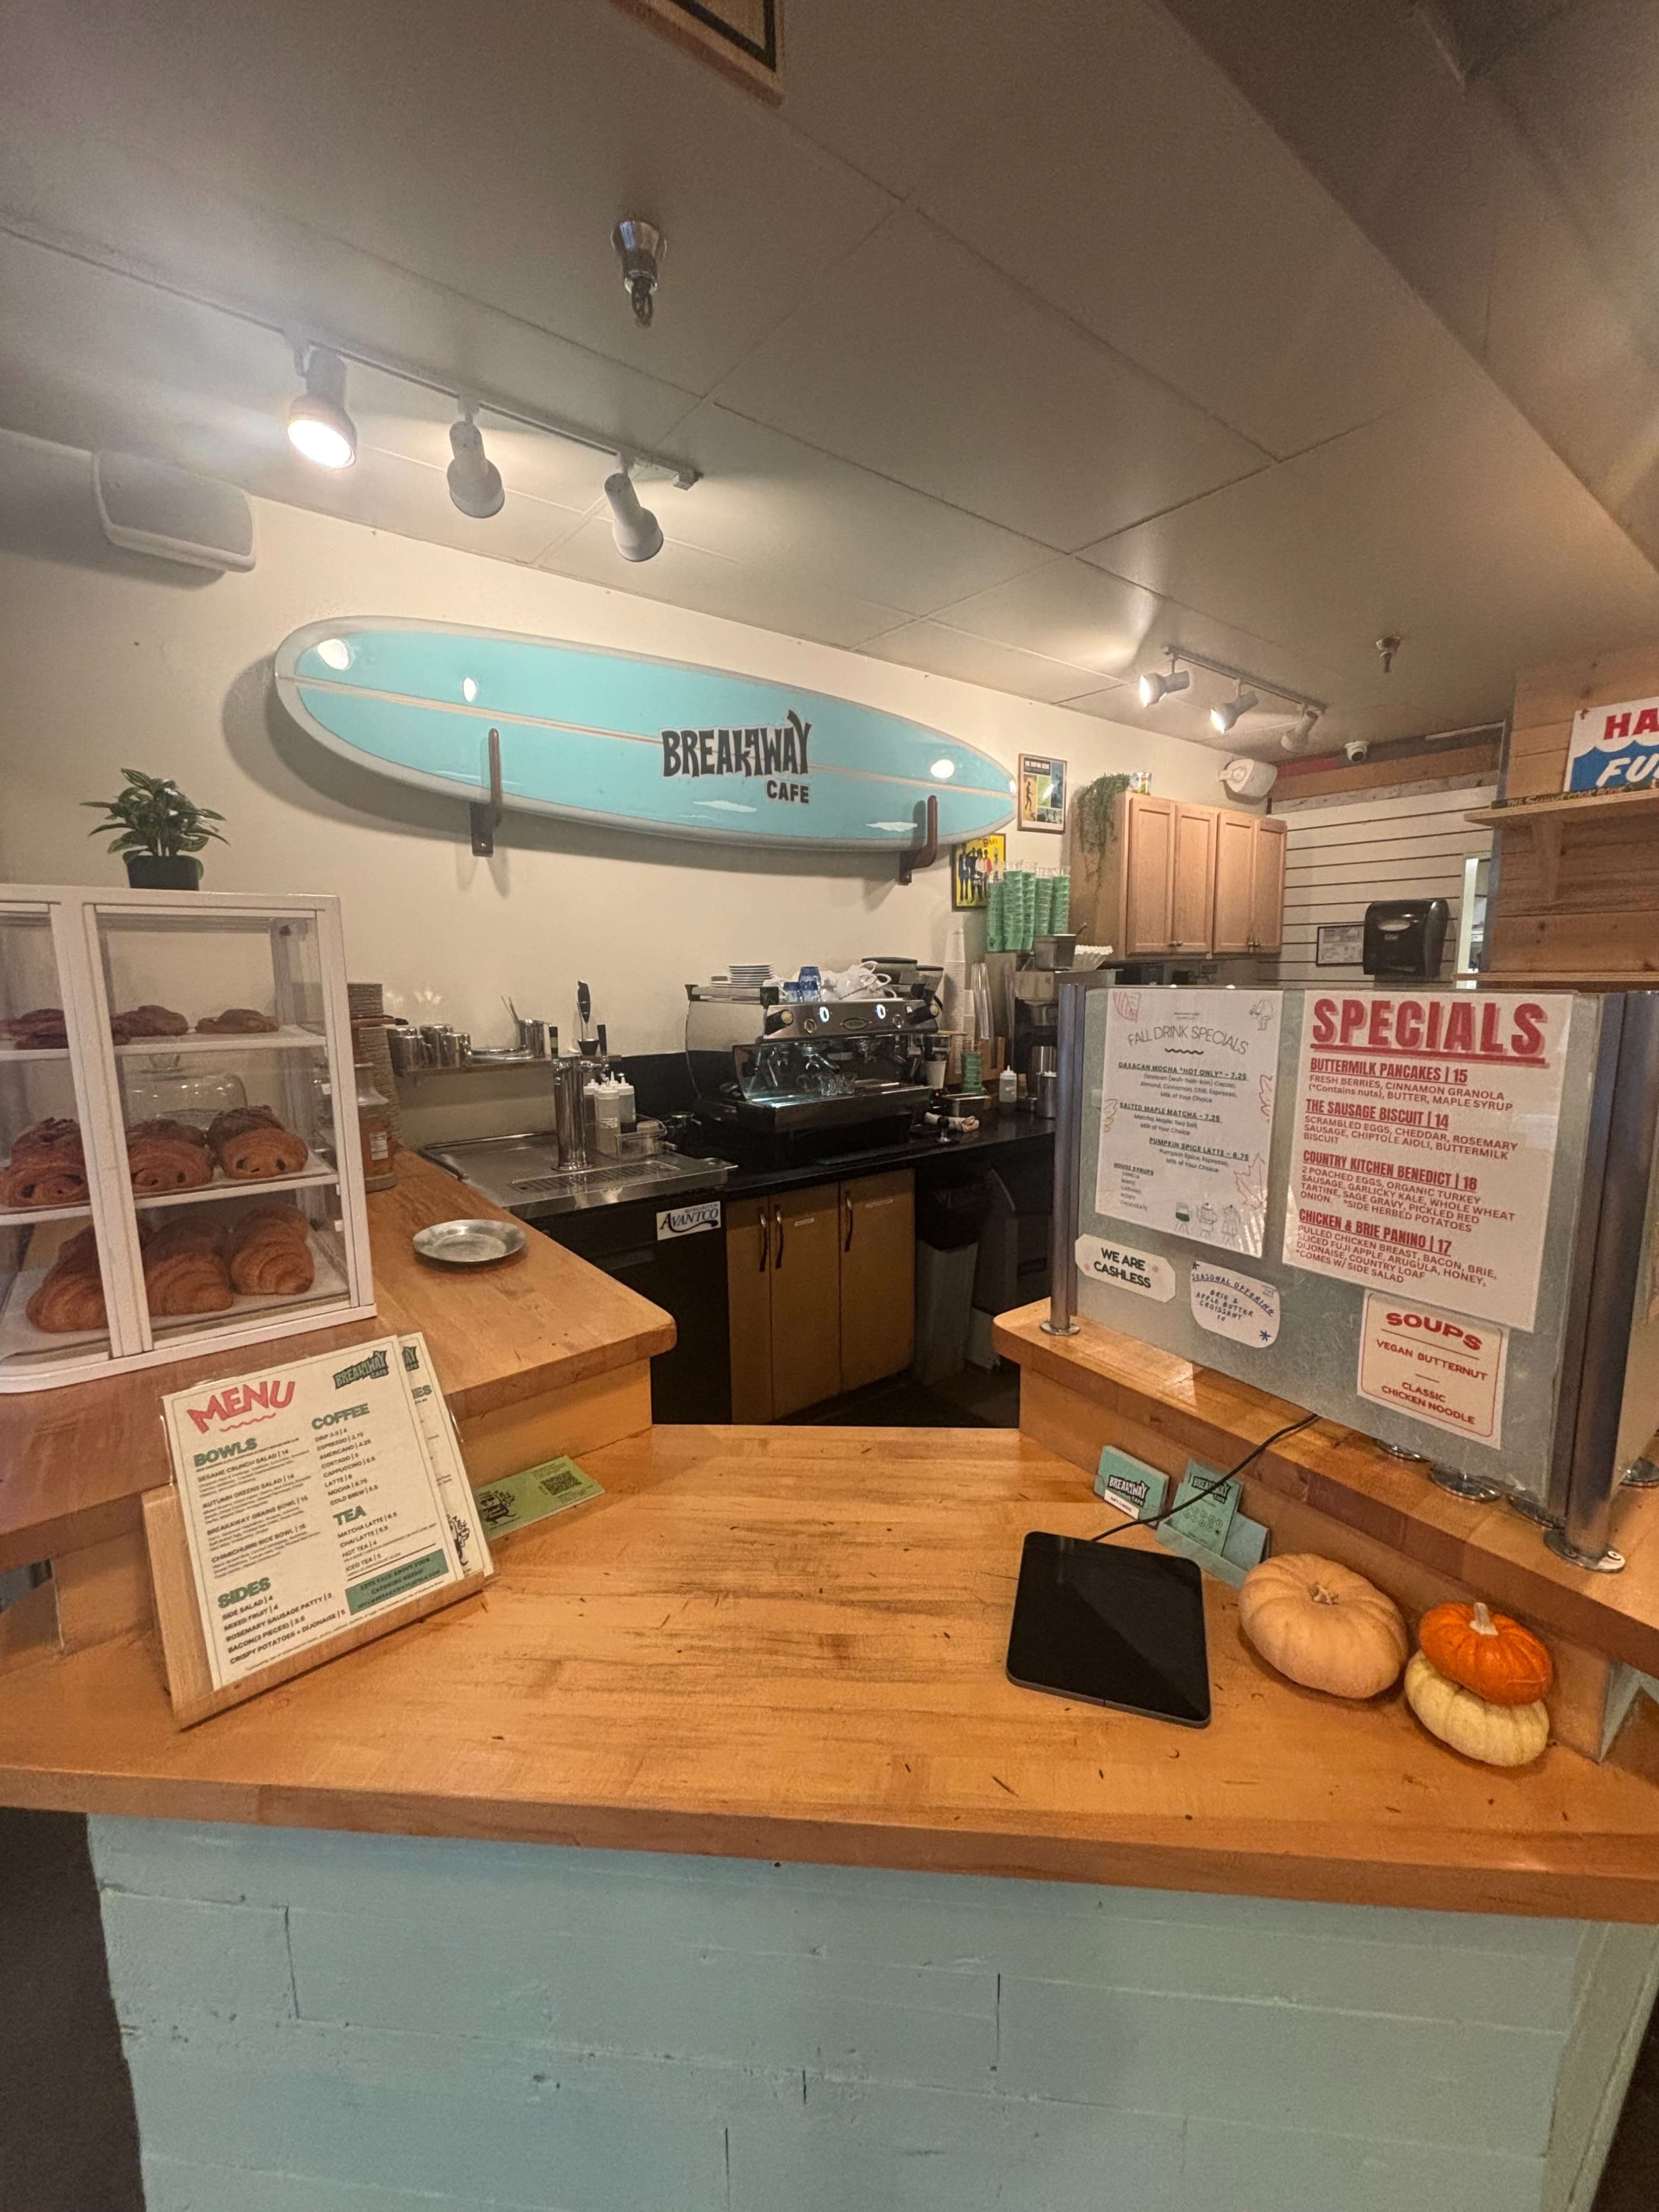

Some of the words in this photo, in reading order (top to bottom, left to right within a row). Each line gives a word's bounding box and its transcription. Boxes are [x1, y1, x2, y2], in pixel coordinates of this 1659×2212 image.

[661, 709, 812, 778] BREAKAWAY
[766, 780, 809, 804] CAFE
[1128, 1029, 1152, 1046] FALL
[1154, 1025, 1188, 1040] DRINK
[1191, 1026, 1249, 1055] SPECIALS
[1312, 998, 1548, 1057] SPECIALS
[1118, 1062, 1150, 1070] OAXACAN
[1310, 1057, 1376, 1075] BUTTERMILK
[1379, 1062, 1441, 1081] PANCAKES
[1452, 1068, 1468, 1083] 15
[1309, 1074, 1338, 1084] FRESH
[1385, 1081, 1445, 1095] CINNAMON
[1447, 1087, 1504, 1100] GRANOLA
[1119, 1102, 1142, 1110] SALTED
[1142, 1105, 1165, 1114] MAPLE
[1166, 1108, 1197, 1119] MATCHA
[1306, 1098, 1325, 1113] THE
[1327, 1101, 1376, 1119] SAUSAGE
[1379, 1107, 1424, 1125] BISCUIT
[1435, 1113, 1449, 1128] 14
[1432, 1095, 1471, 1107] MAPLE
[1473, 1100, 1513, 1111] SYRUP
[1303, 1132, 1339, 1144] BISCUIT
[1305, 1115, 1361, 1129] SCRAMBLED
[1452, 1135, 1518, 1150] ROSEMARY
[1351, 1130, 1399, 1144] CHIPTOLE
[1435, 1142, 1508, 1160] BUTTERMILK
[1149, 1137, 1179, 1148] PUMPKIN
[1180, 1143, 1201, 1152] SPICE
[1202, 1147, 1224, 1156] LATTE
[1303, 1150, 1347, 1168] COUNTRY
[1350, 1157, 1394, 1177] KITCHEN
[1397, 1165, 1452, 1186] BENEDICT
[1463, 1176, 1477, 1191] 18
[1309, 1166, 1354, 1181] POACHED
[1386, 1181, 1434, 1196] ORGANIC
[1437, 1190, 1481, 1204] TURKEY
[1342, 1190, 1367, 1202] SAGE
[1408, 1203, 1454, 1219] PICKLED
[1456, 1212, 1479, 1224] RED
[1348, 1182, 1396, 1198] GARLICKY
[1430, 1198, 1470, 1213] WHOLE
[1472, 1205, 1515, 1221] WHEAT
[1299, 1208, 1341, 1229] CHICKEN
[1344, 1220, 1352, 1232] &
[1355, 1220, 1380, 1238] BRIE
[1382, 1227, 1426, 1248] PANINO
[1437, 1239, 1452, 1254] 17
[1371, 1205, 1412, 1220] HERBED
[1414, 1214, 1471, 1232] POTATOES
[1297, 1233, 1328, 1246] SLICED
[1330, 1240, 1351, 1252] FUJI
[1298, 1224, 1332, 1238] PULLED
[1334, 1233, 1376, 1249] CHICKEN
[1101, 1247, 1120, 1263] WE
[1122, 1255, 1146, 1271] ARE
[1333, 1258, 1346, 1268] W/
[1347, 1262, 1369, 1274] SIDE
[1371, 1268, 1404, 1283] SALAD
[1348, 1254, 1396, 1271] COUNTRY
[1398, 1266, 1425, 1278] LOAF
[1093, 1261, 1151, 1288] CASHLESS
[1192, 1274, 1230, 1285] SEASONAL
[1234, 1281, 1274, 1315] OFFERING
[1196, 1292, 1219, 1305] APPLE
[1223, 1302, 1254, 1317] BUTTER
[1210, 1290, 1228, 1300] BRIE
[1199, 1300, 1243, 1320] CROISSANT
[1386, 1312, 1482, 1351] SOUPS
[1376, 1338, 1413, 1357] VEGAN
[1417, 1352, 1487, 1380] BUTTERNUT
[1381, 1385, 1426, 1407] CHICKEN
[1428, 1401, 1475, 1424] NOODLE
[1402, 1382, 1445, 1402] CLASSIC
[186, 1380, 296, 1434] MENU
[311, 1402, 370, 1430] COFFEE
[193, 1437, 257, 1467] BOWLS
[332, 1505, 367, 1526] TEA
[217, 1576, 271, 1608] SIDES
